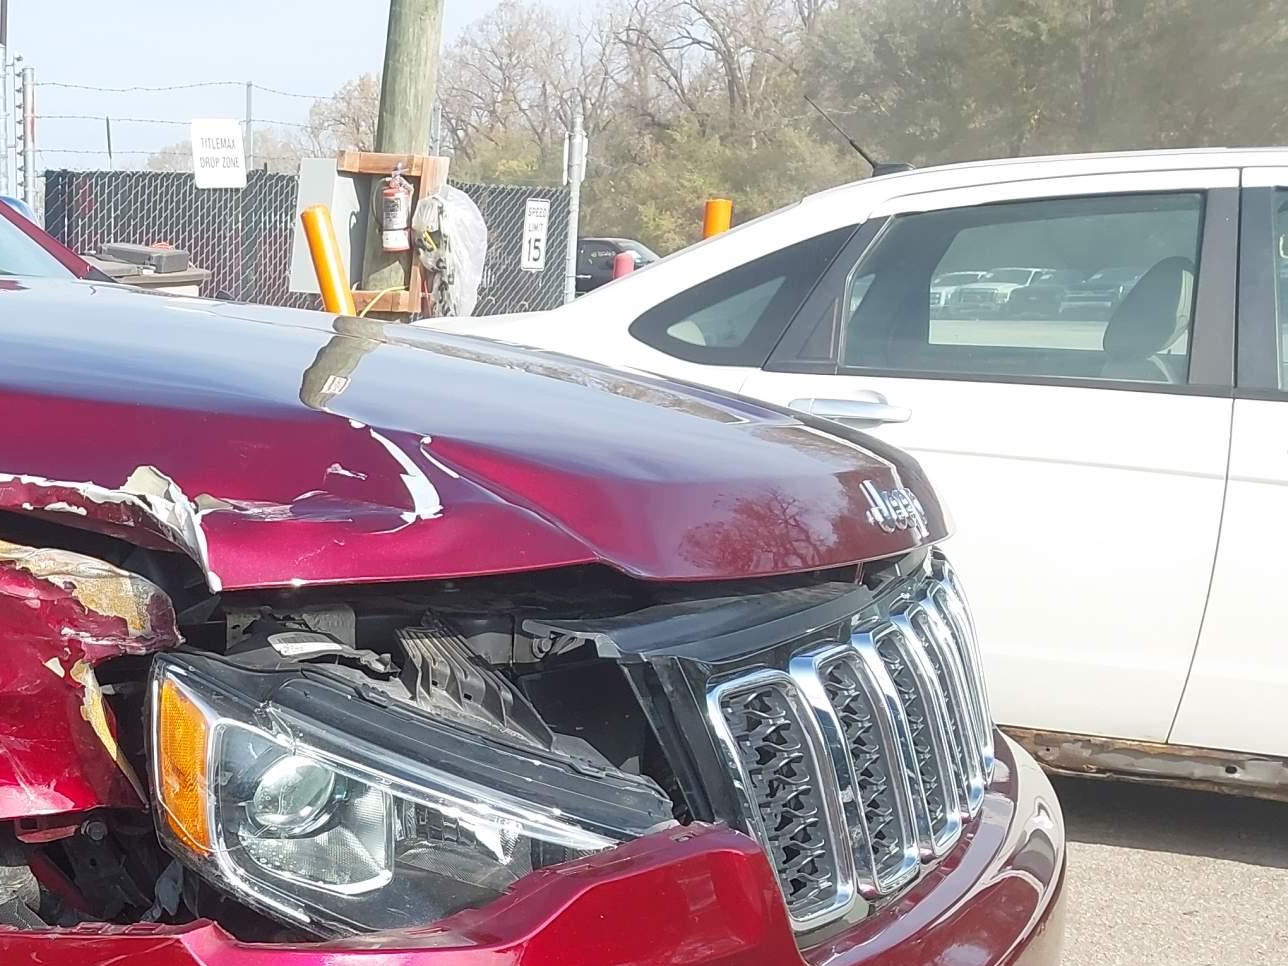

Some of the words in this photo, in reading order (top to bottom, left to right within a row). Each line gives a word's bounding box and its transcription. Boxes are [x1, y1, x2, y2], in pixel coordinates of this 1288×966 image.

[200, 137, 236, 150] TITLEMAX
[200, 156, 220, 168] DROP
[222, 156, 240, 168] ZONE
[527, 238, 542, 262] 15
[859, 480, 930, 538] Jeep
